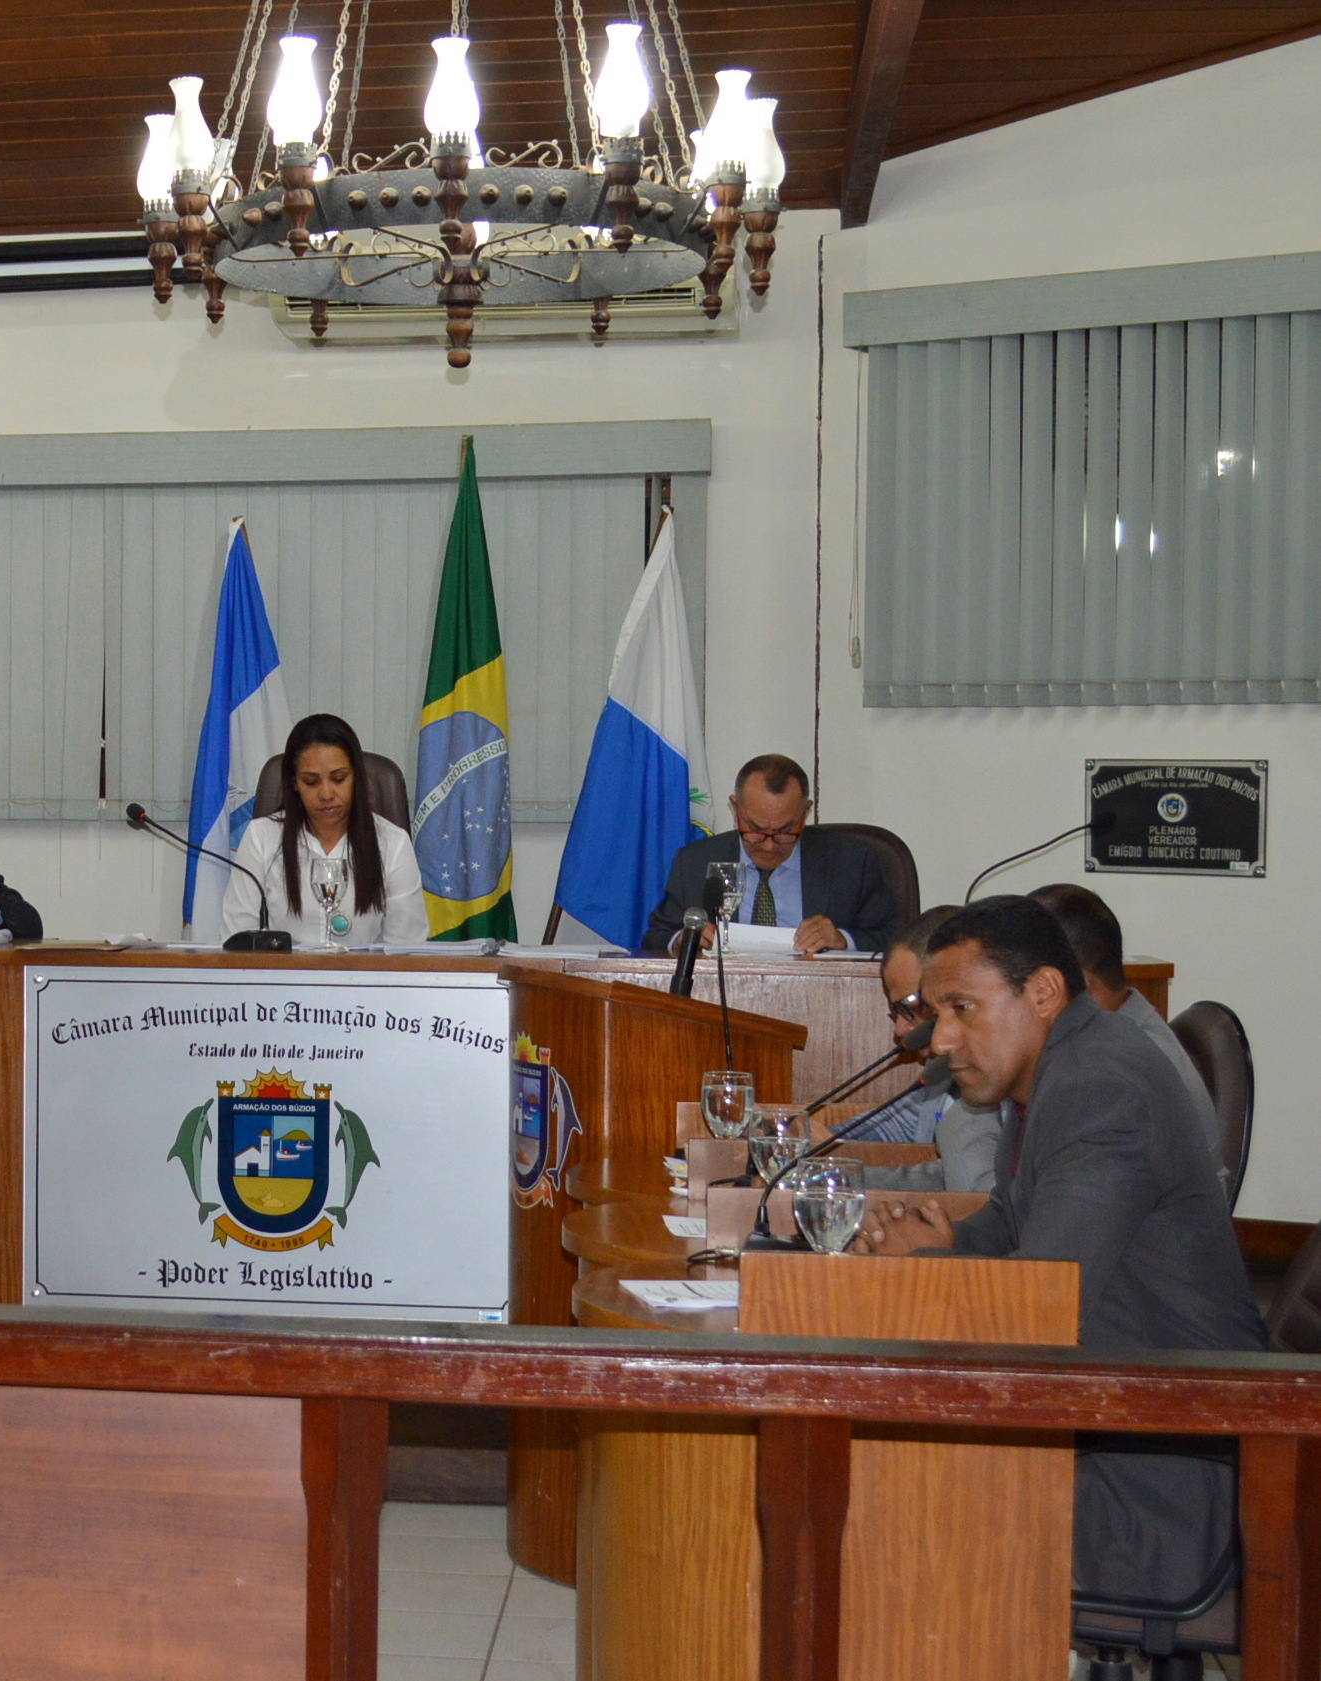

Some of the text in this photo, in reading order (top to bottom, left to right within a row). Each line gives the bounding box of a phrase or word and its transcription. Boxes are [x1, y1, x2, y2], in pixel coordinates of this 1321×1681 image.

[412, 740, 506, 839] DEM E PROGRESSO
[1092, 777, 1124, 799] CÂMARA
[1123, 767, 1164, 786] MUNICIPAL
[1166, 766, 1177, 779] DE
[1215, 773, 1232, 789] DOS
[1231, 778, 1259, 801] BÚZIOS
[1149, 825, 1196, 836] PLENÁRIO
[1148, 836, 1197, 845] VEREADOR
[1199, 847, 1241, 860] COUTINHO
[51, 1001, 508, 1054] Câmara Municipal de Armação dos Búzios
[189, 1043, 364, 1060] Estado do Rio de Janeiro
[233, 1103, 270, 1112] ARMAÇÃO
[288, 1104, 316, 1112] BÚZIOS
[244, 1234, 305, 1248] 1740 1995
[156, 1259, 229, 1288] Poder
[237, 1261, 373, 1292] Legislativo
